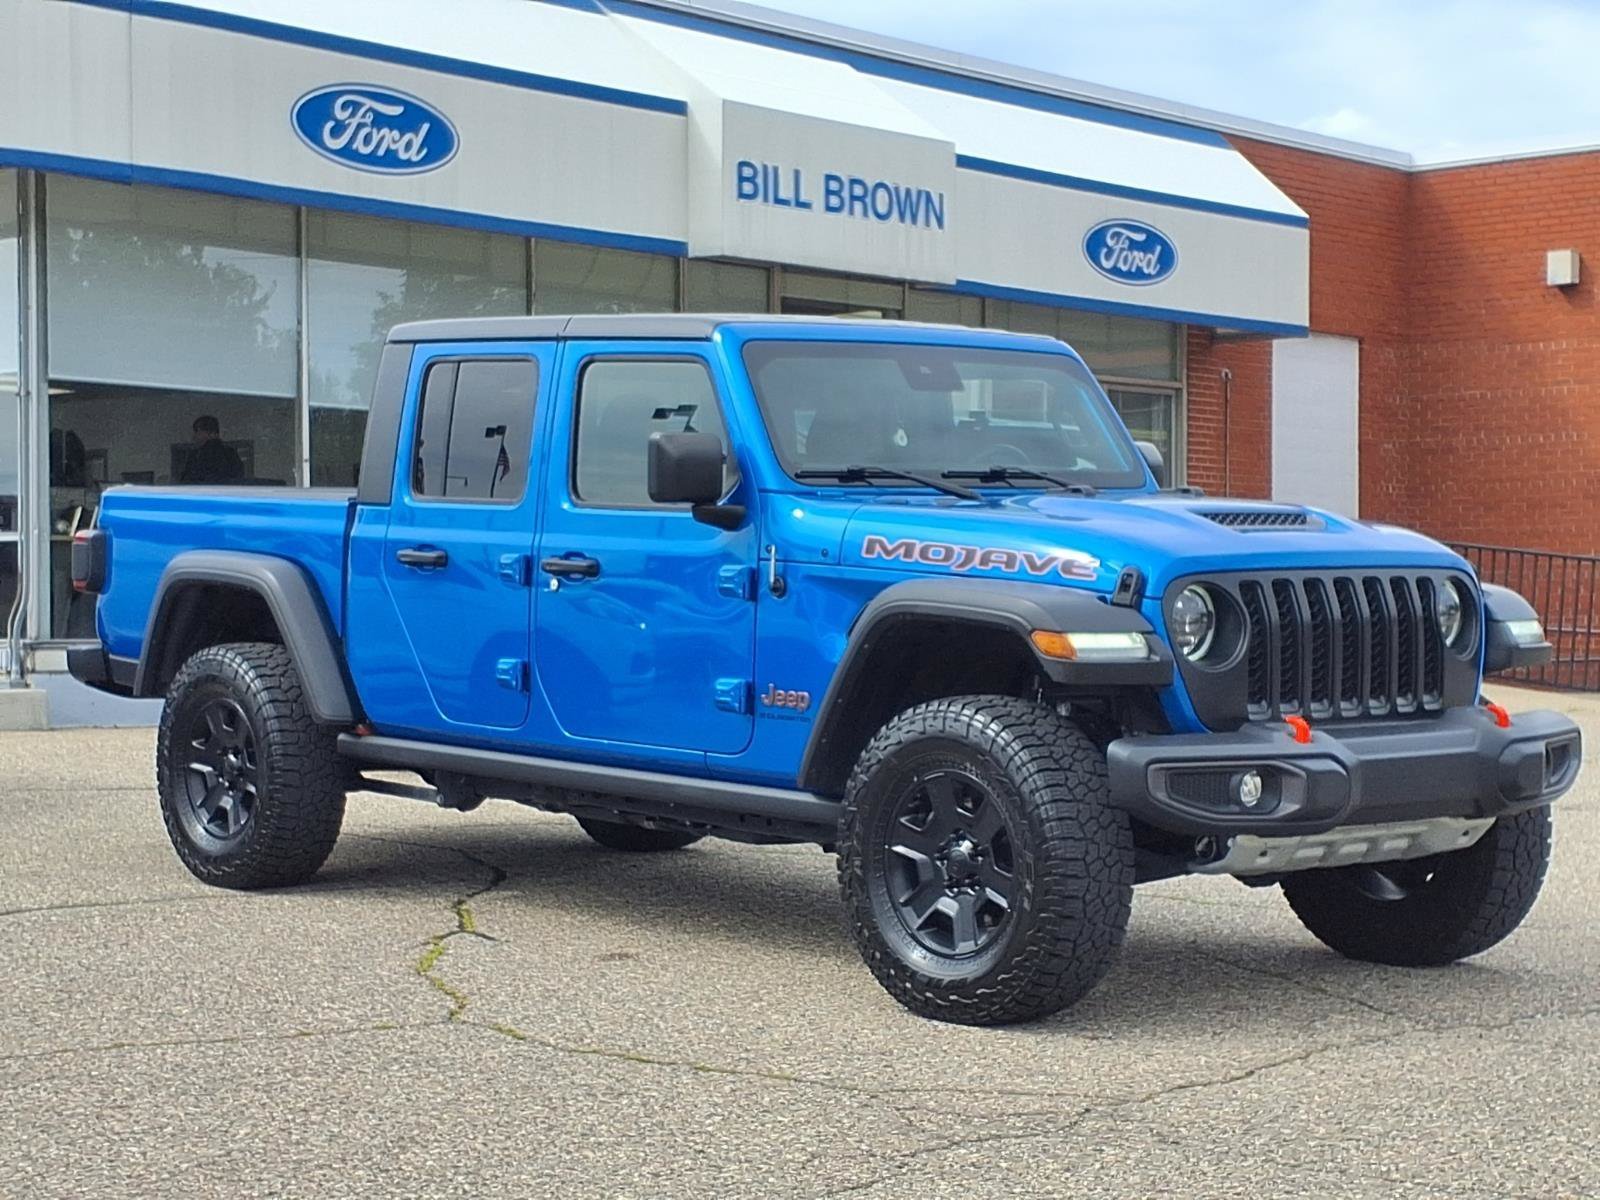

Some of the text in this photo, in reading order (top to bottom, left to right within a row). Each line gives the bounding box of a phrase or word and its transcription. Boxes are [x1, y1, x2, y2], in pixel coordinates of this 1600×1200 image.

[322, 94, 431, 162] Ford
[736, 159, 945, 231] BILL BROWN
[1100, 227, 1162, 275] Ford
[862, 535, 1101, 582] MOJAVE
[760, 682, 811, 713] Jeep
